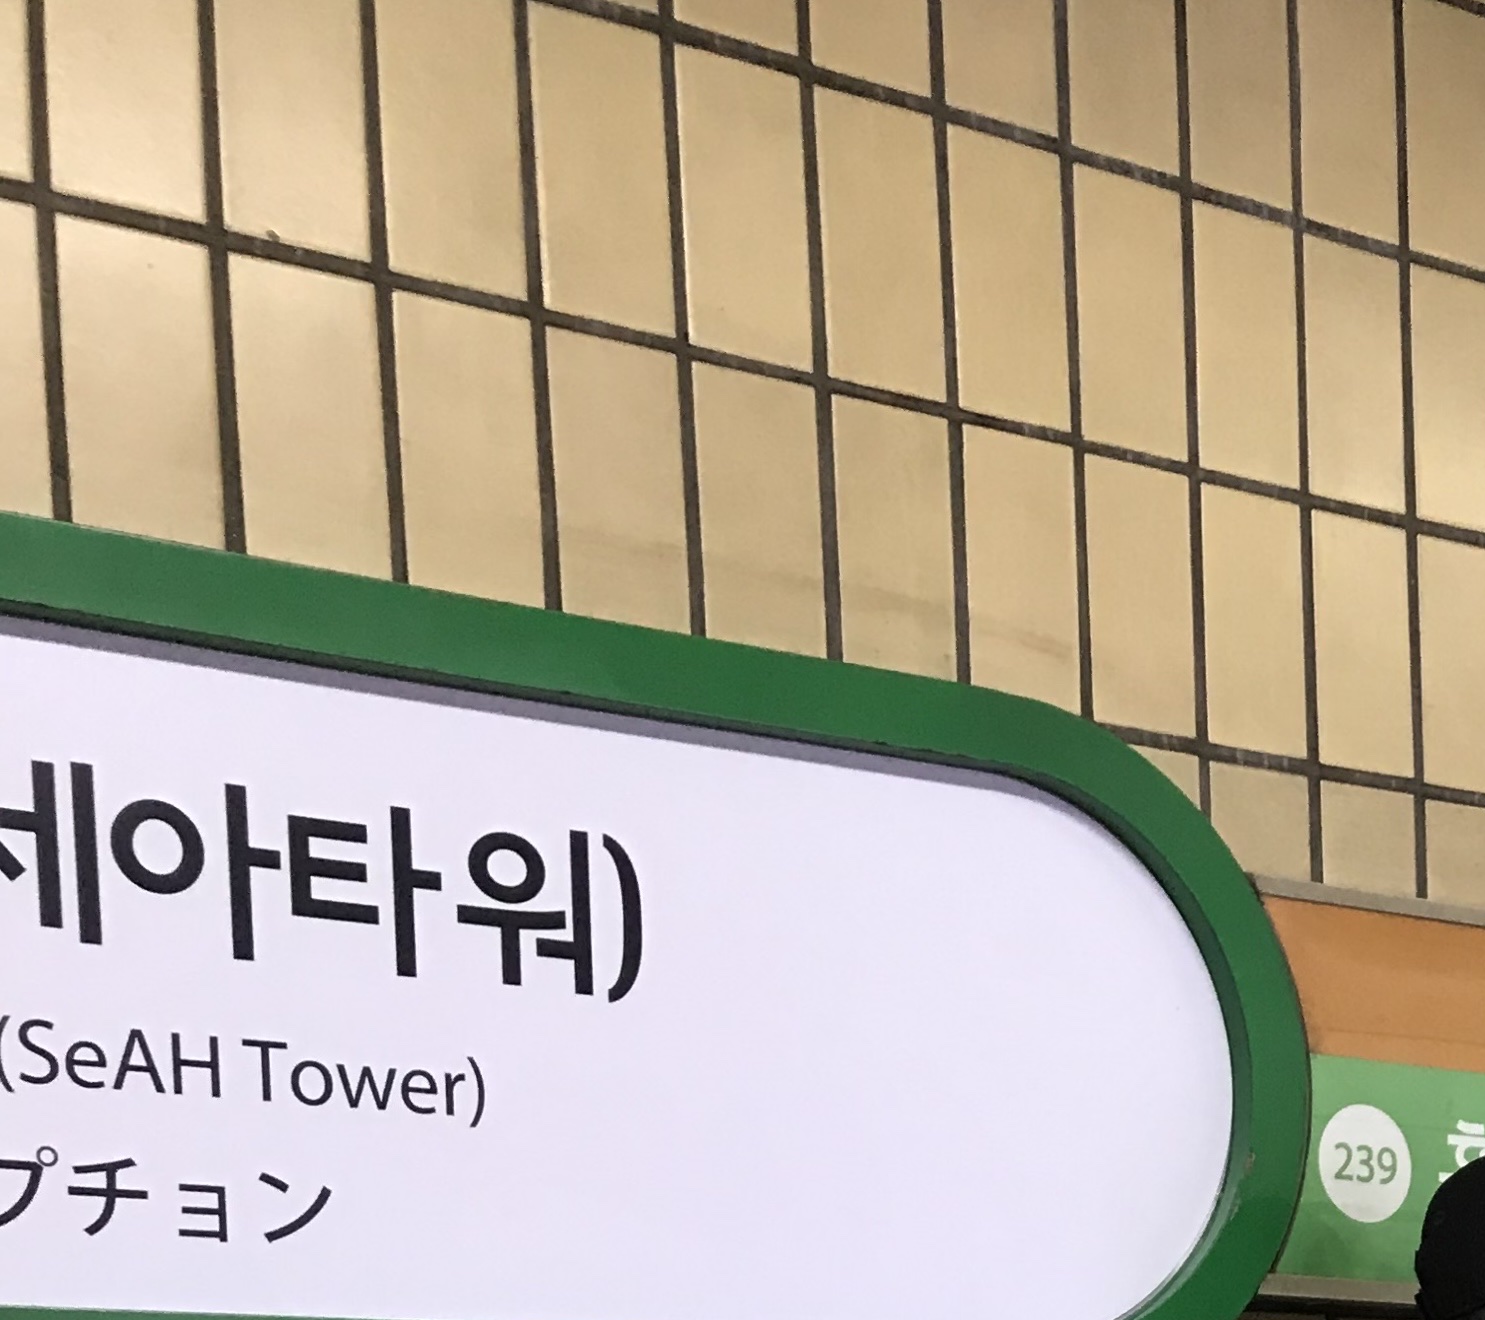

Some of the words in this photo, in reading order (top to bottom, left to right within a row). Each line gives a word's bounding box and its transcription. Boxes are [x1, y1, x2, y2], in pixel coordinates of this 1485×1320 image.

[0, 760, 643, 1003] 세아타워)
[0, 1015, 221, 1098] (SeAH
[241, 1038, 485, 1128] Tower)
[1333, 1142, 1398, 1186] 239
